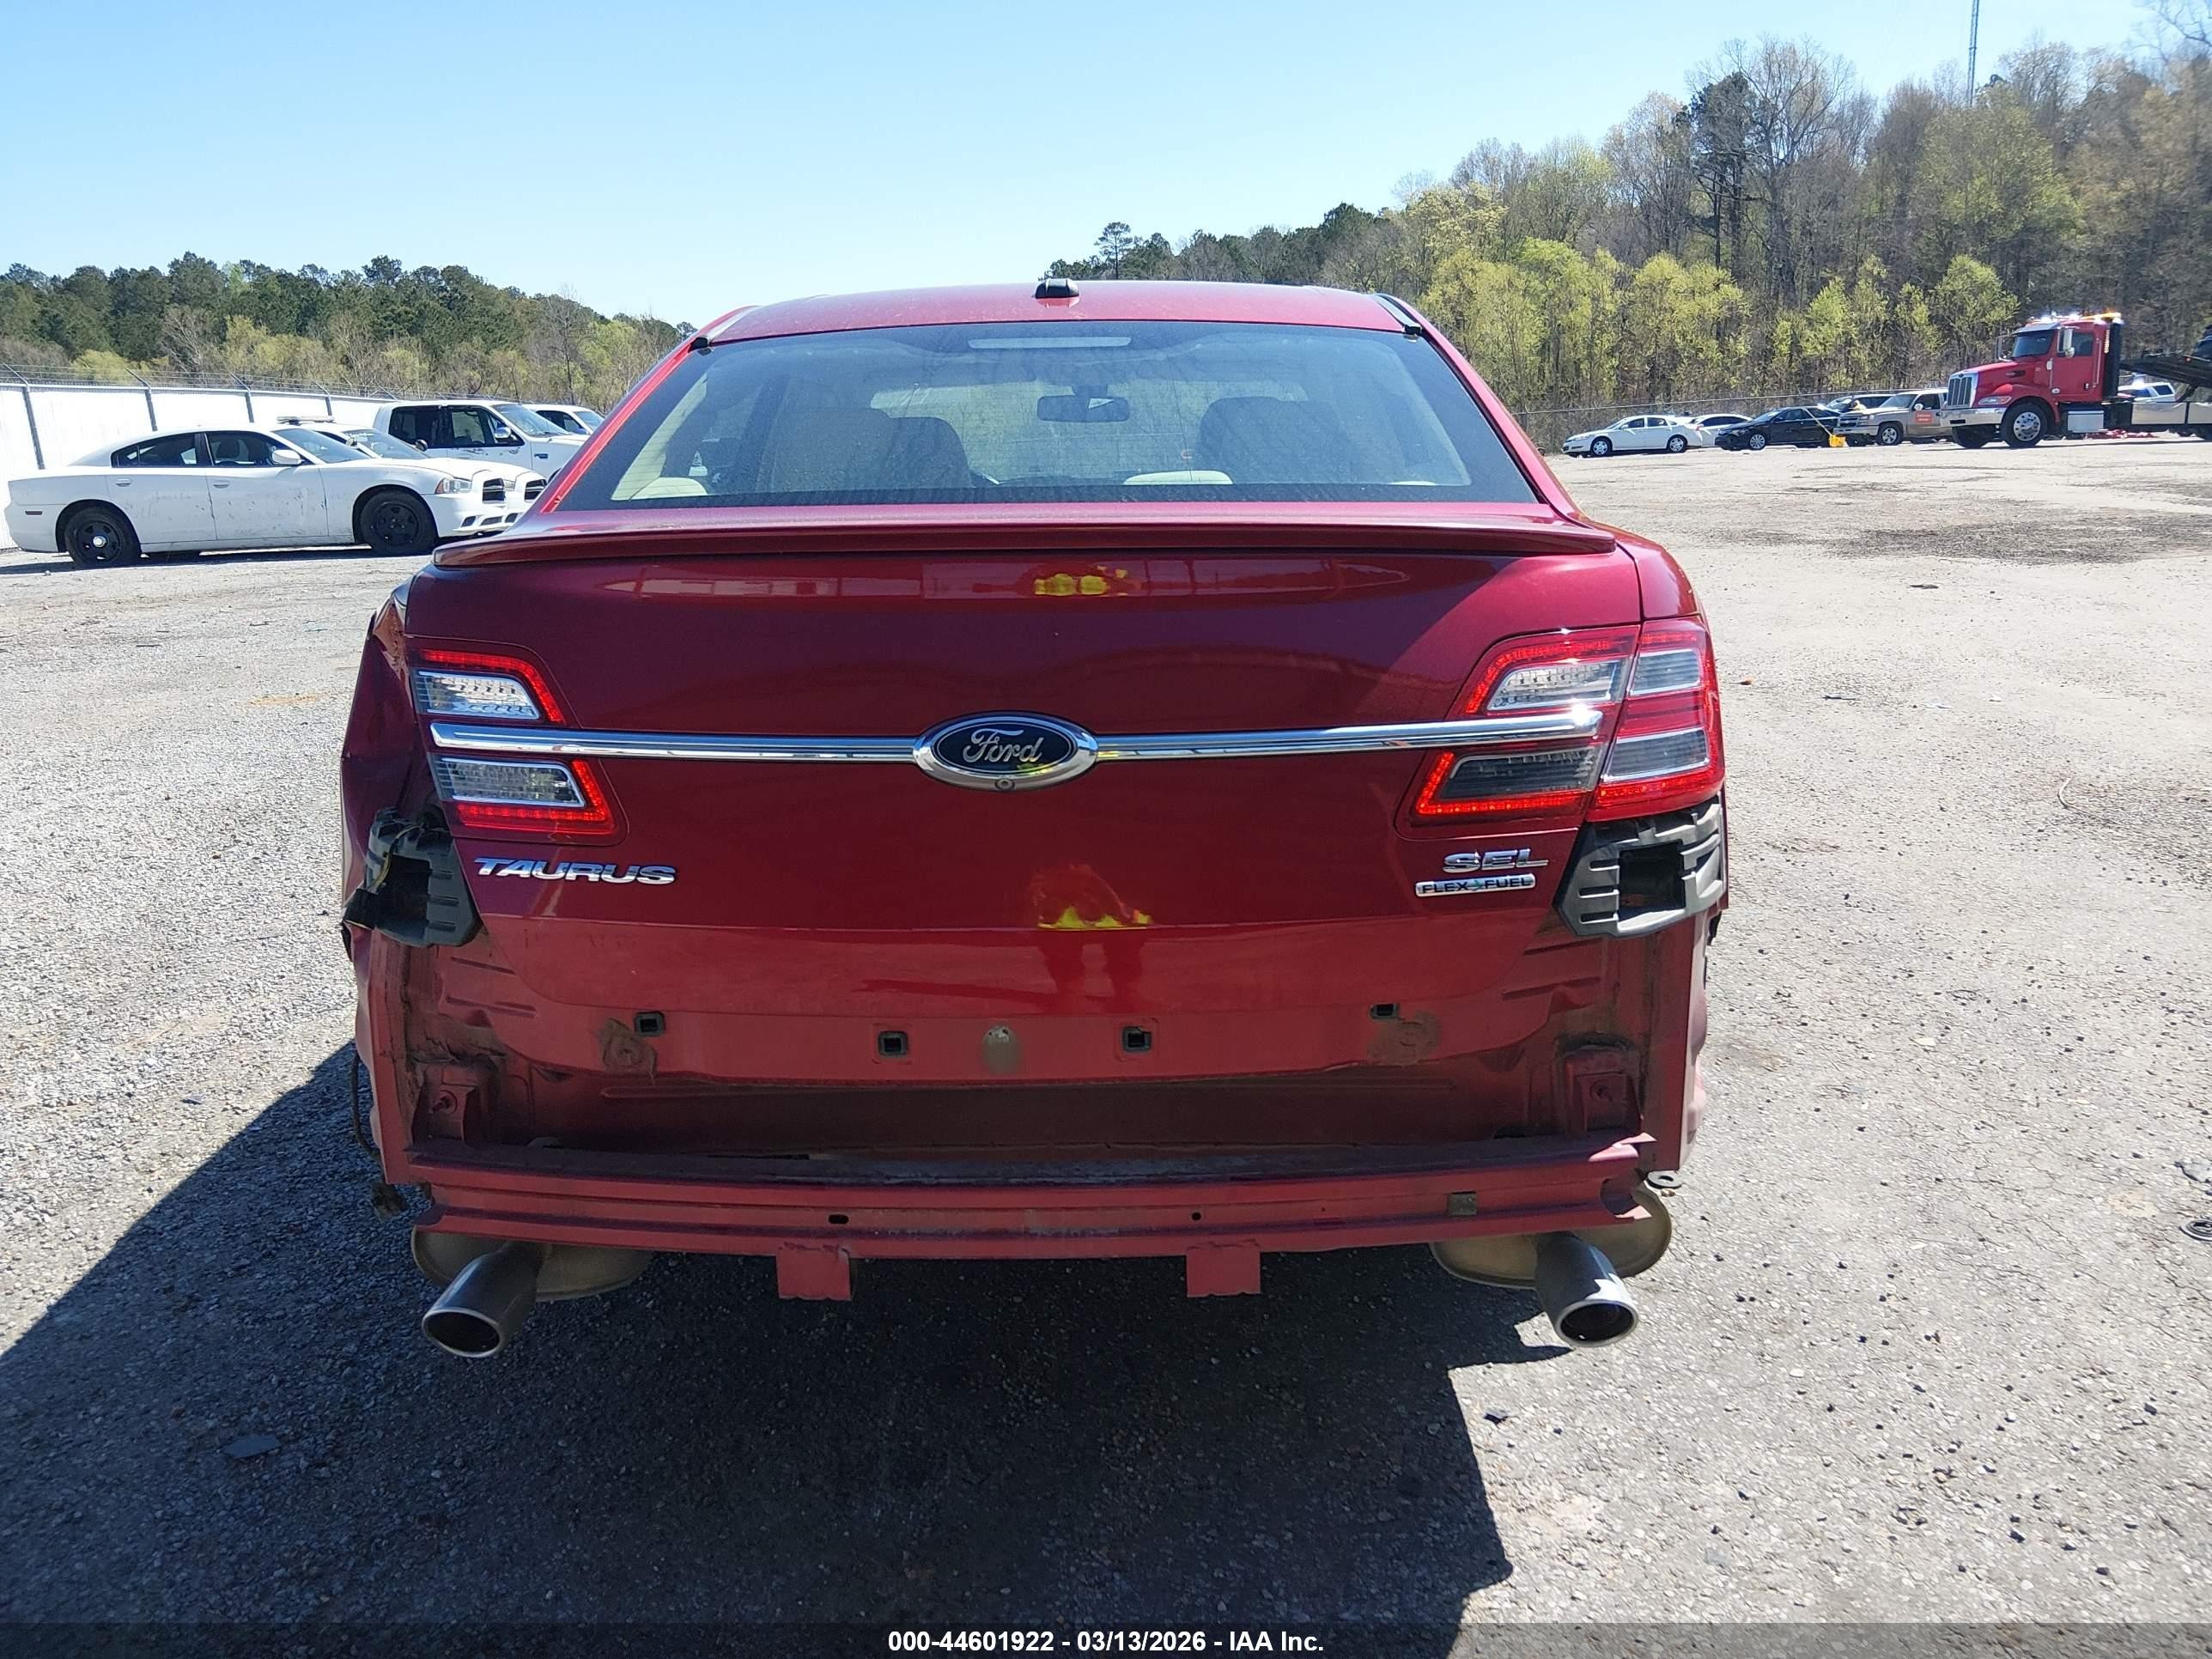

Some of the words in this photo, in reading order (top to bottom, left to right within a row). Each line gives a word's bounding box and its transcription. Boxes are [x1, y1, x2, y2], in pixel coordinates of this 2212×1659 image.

[963, 728, 1044, 763] Ford
[474, 857, 677, 885] TAURUS
[1443, 848, 1549, 873] SEL
[1422, 881, 1468, 894] FLEX
[1485, 877, 1533, 890] FUEL
